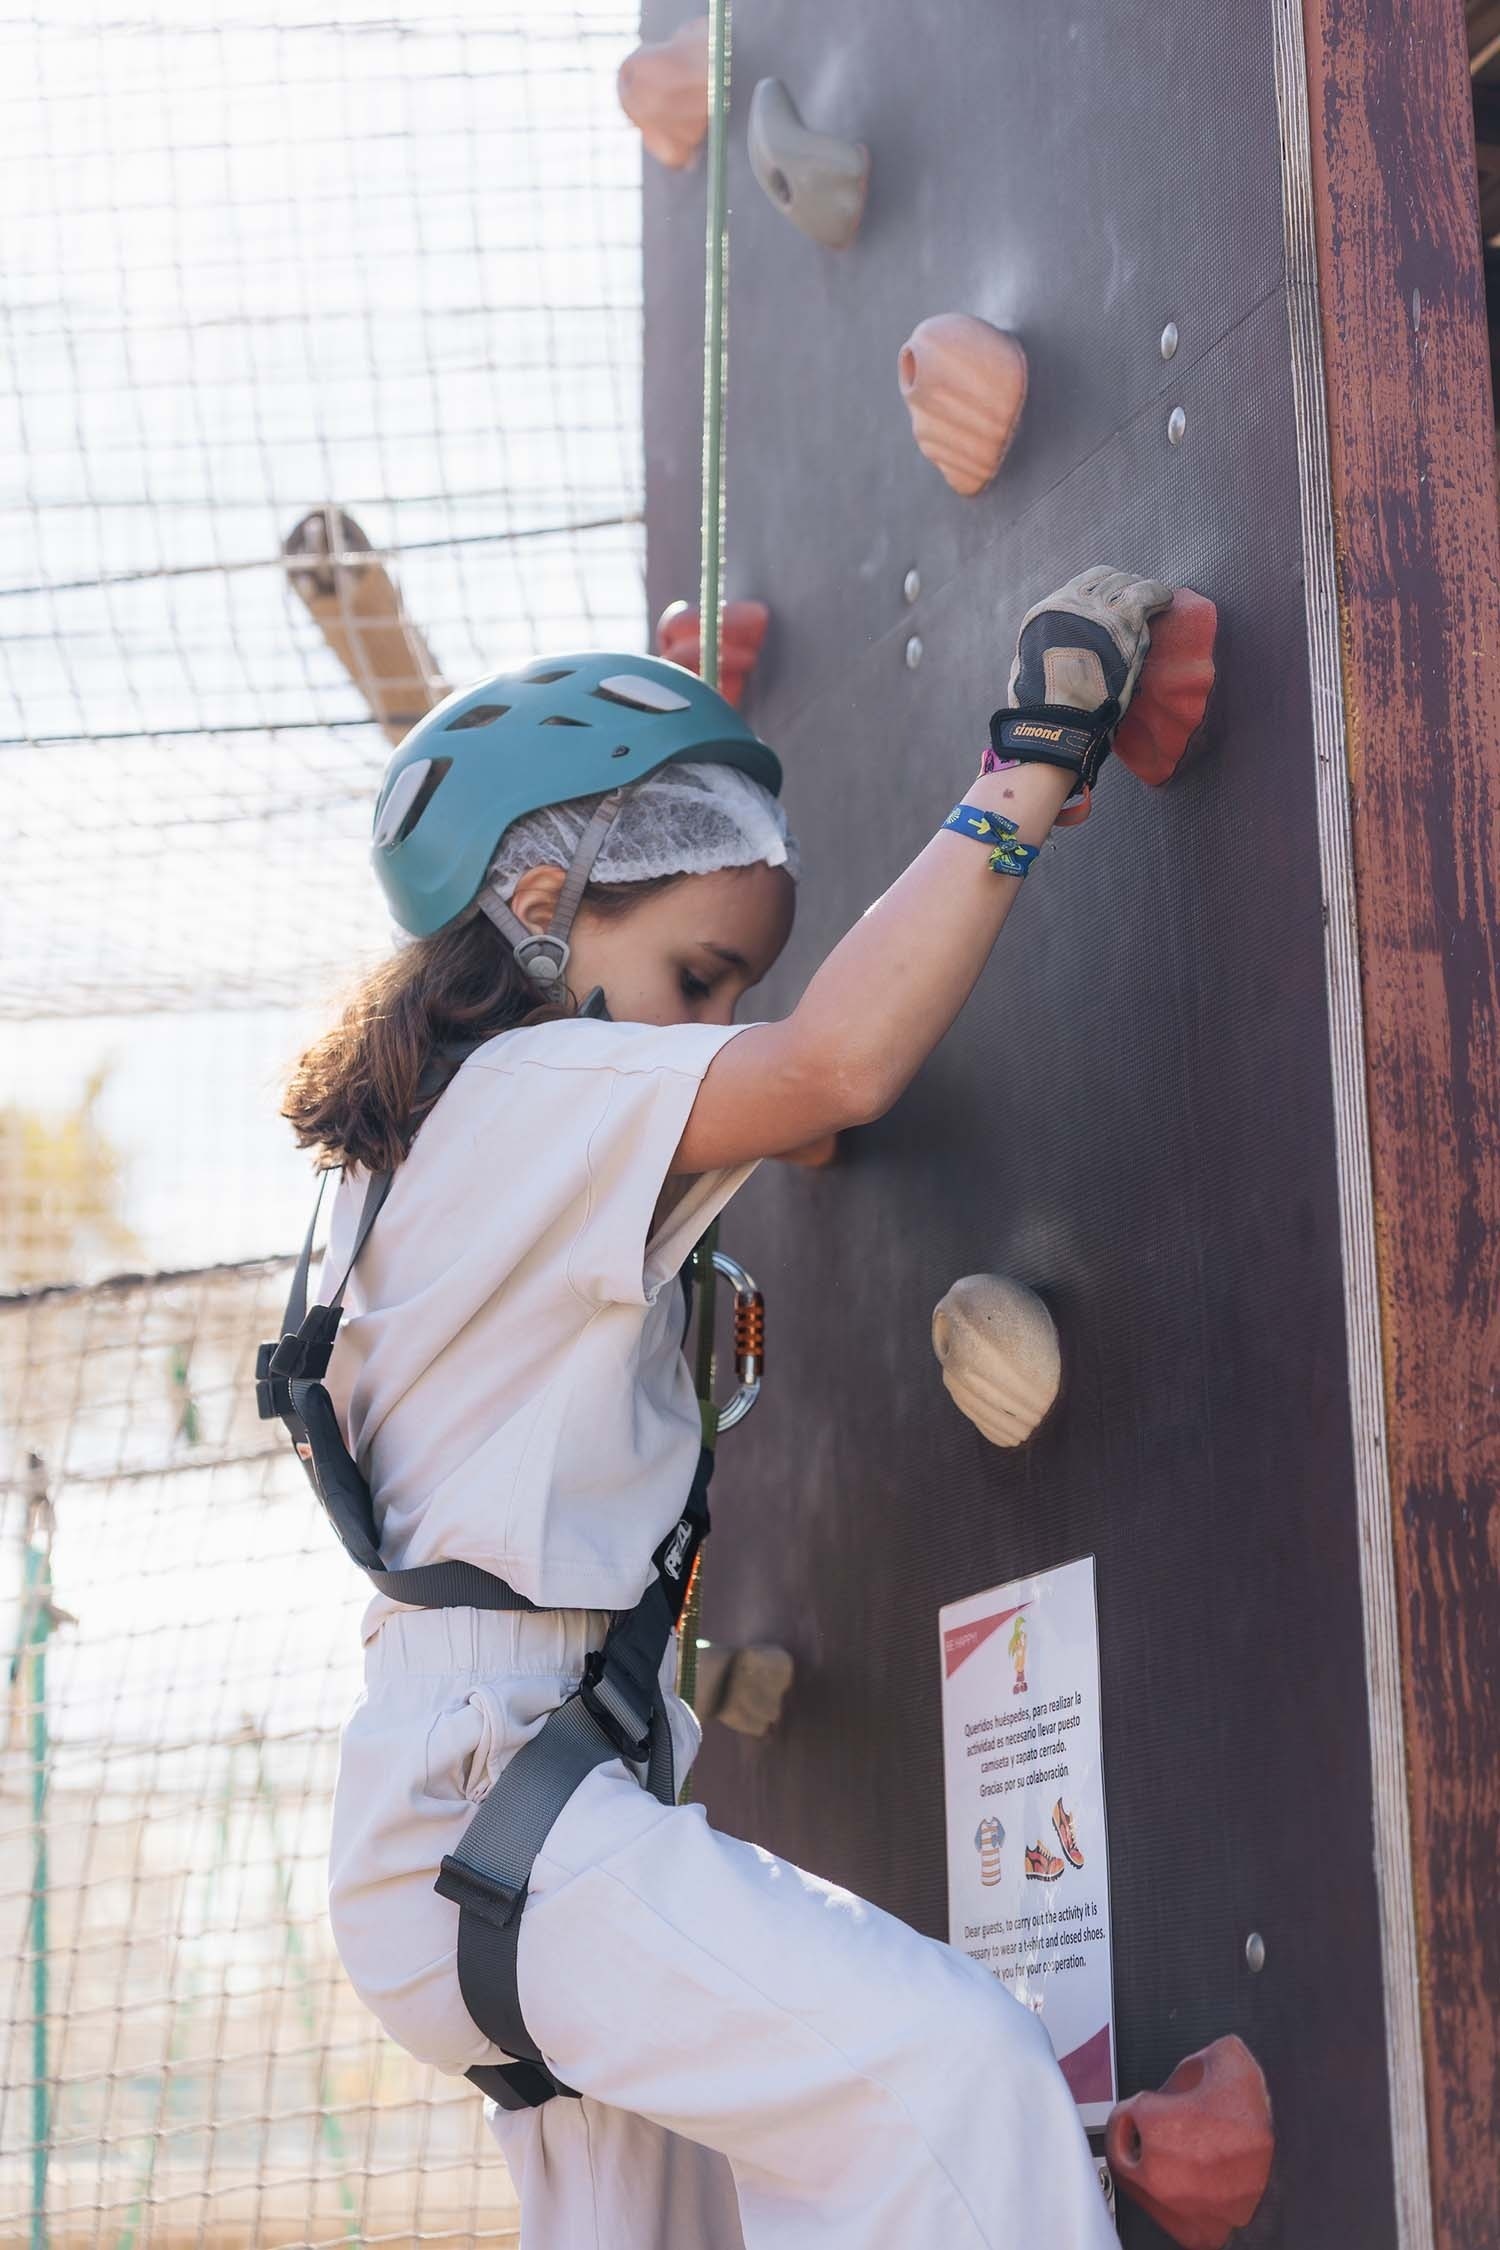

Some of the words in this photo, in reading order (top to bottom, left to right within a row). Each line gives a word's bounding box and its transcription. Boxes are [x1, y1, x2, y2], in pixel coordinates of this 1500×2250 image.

[1012, 722, 1063, 741] simond
[964, 1719, 993, 1737] Queridos
[994, 1708, 1031, 1727] huéspedes,
[1032, 1704, 1047, 1720] para
[1049, 1695, 1074, 1712] realizar
[1075, 1691, 1082, 1705] la
[967, 1736, 995, 1757] actividad
[997, 1738, 1004, 1748] es
[1005, 1726, 1037, 1745] necesario
[1038, 1722, 1056, 1737] llevar
[1058, 1714, 1080, 1735] puesto
[981, 1755, 1009, 1774] camiseta
[1010, 1755, 1015, 1768] y
[1016, 1747, 1038, 1766] zapato
[1039, 1739, 1067, 1757] cerrado.
[980, 1782, 1003, 1798] Gracias
[1004, 1778, 1016, 1795] por
[1017, 1777, 1025, 1788] su
[964, 1925, 980, 1939] Dear
[982, 1921, 1005, 1939] guests,
[1006, 1919, 1012, 1932] to
[1014, 1916, 1031, 1931] carry
[1032, 1912, 1044, 1926] out
[1045, 1910, 1057, 1925] the
[1058, 1904, 1083, 1921] activity
[1085, 1902, 1090, 1917] it
[1091, 1901, 1098, 1916] is
[992, 1944, 999, 1957] to
[1000, 1943, 1016, 1956] wear
[1018, 1942, 1023, 1953] a
[1045, 1931, 1058, 1949] and
[1060, 1927, 1082, 1946] closed
[1083, 1925, 1106, 1942] shoes.
[1001, 1967, 1014, 1982] you
[1026, 1963, 1041, 1978] your
